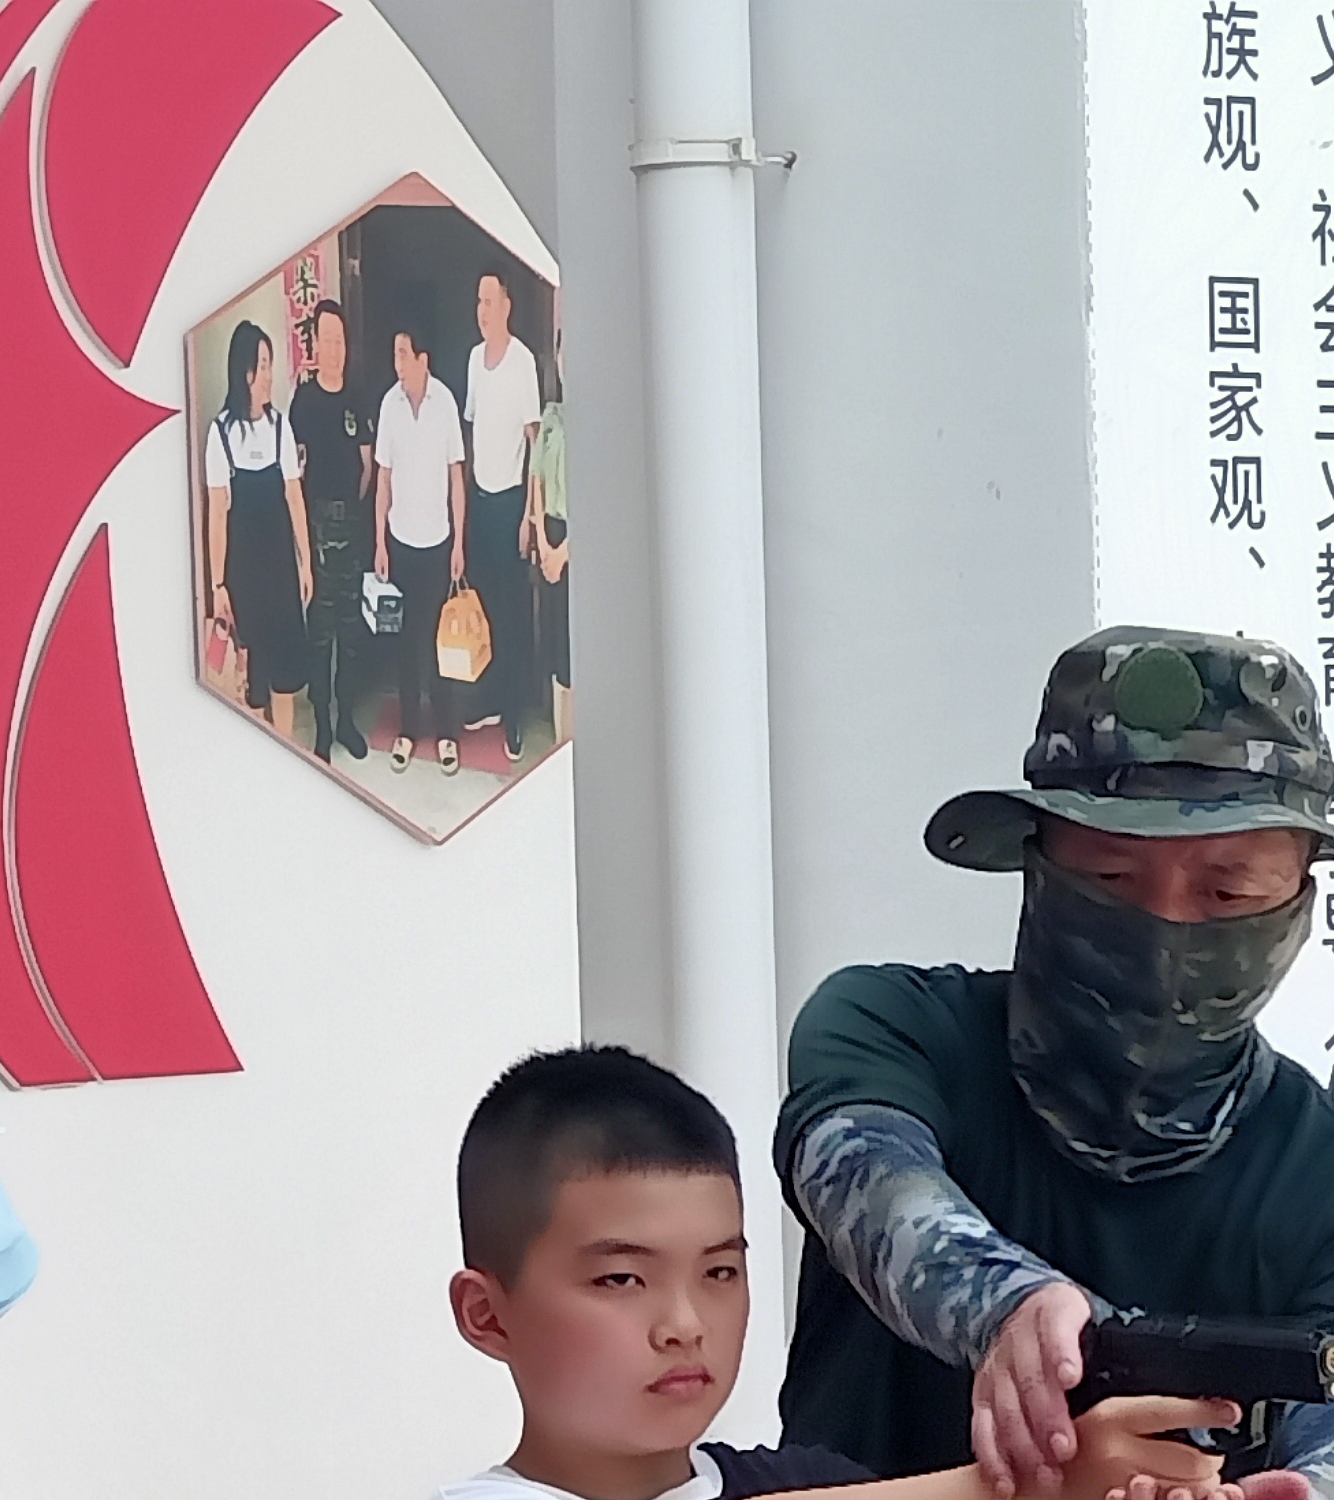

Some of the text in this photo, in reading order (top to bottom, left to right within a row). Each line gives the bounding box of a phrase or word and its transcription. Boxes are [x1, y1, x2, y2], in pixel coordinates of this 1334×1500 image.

[1202, 0, 1266, 638] 族观、国家观、
